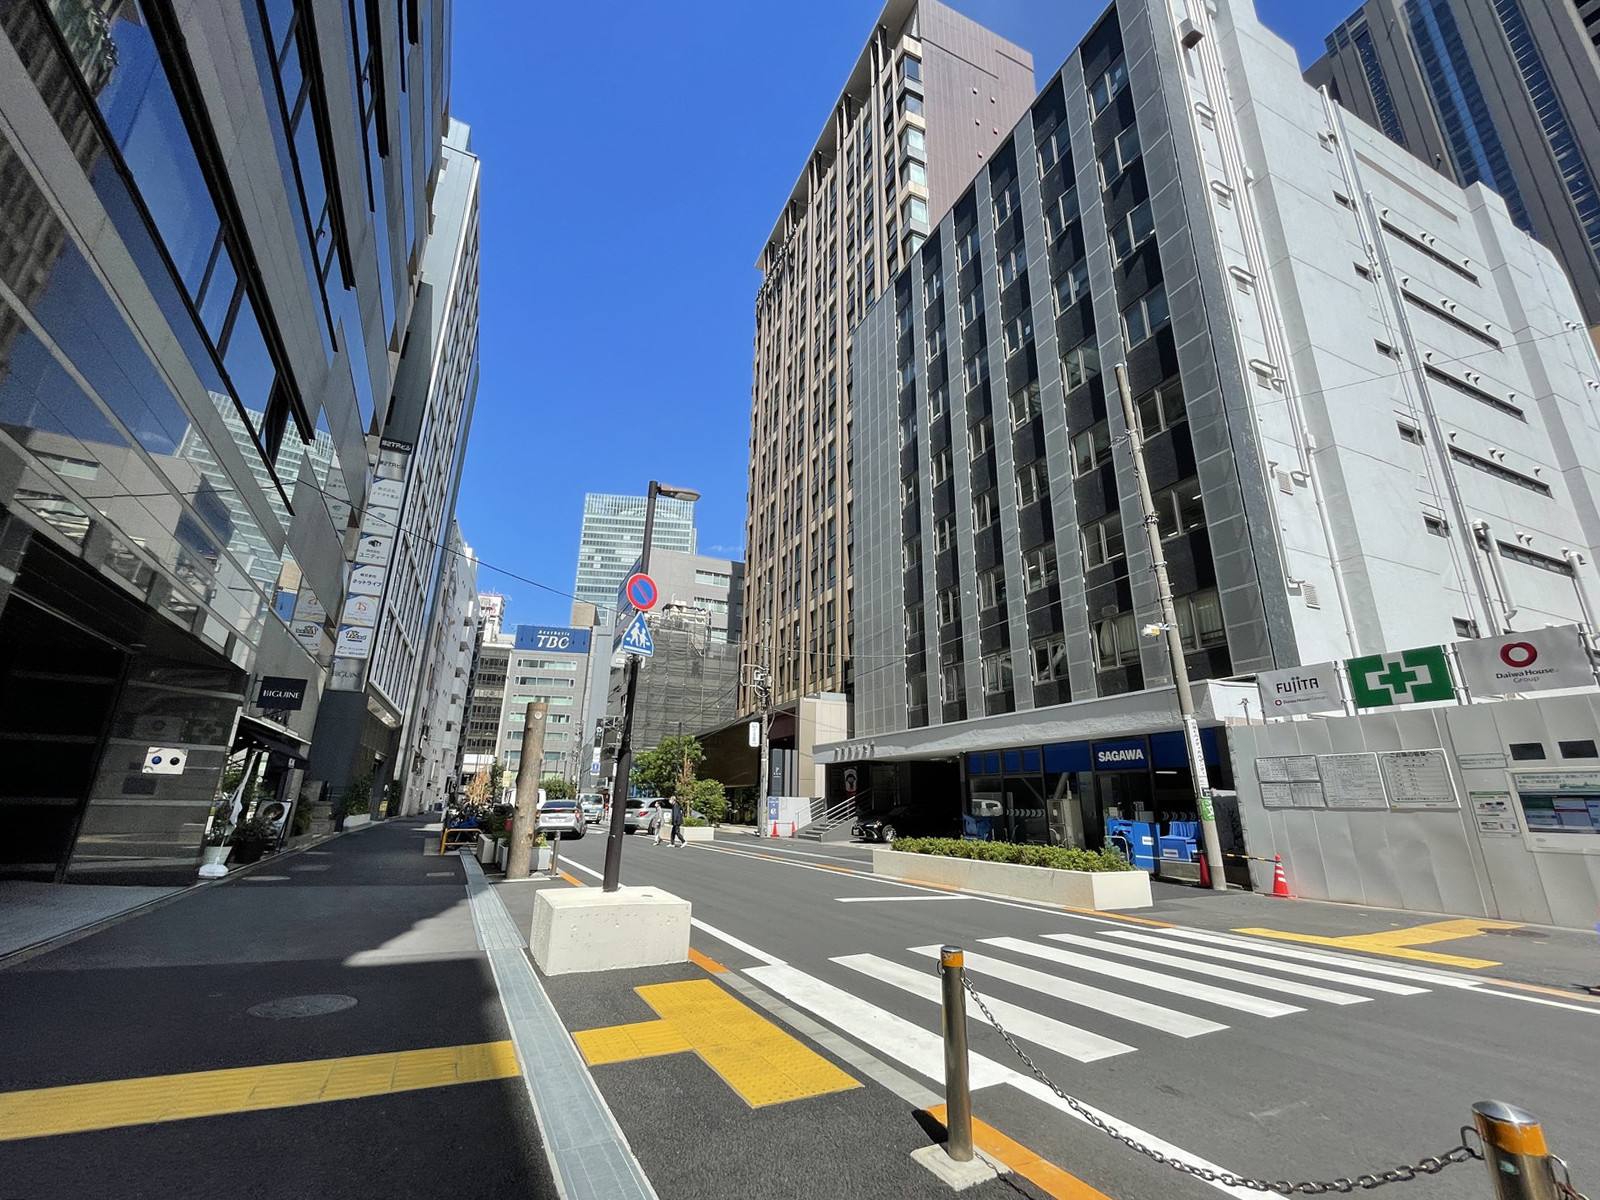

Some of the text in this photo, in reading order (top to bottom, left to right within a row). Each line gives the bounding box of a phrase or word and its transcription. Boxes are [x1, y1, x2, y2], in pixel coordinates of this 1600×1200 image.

[537, 634, 570, 650] TBC
[1496, 667, 1554, 679] Daiwa House
[1513, 676, 1540, 684] Group
[263, 689, 300, 699] BIGUINE
[1098, 748, 1144, 762] SAGAWA
